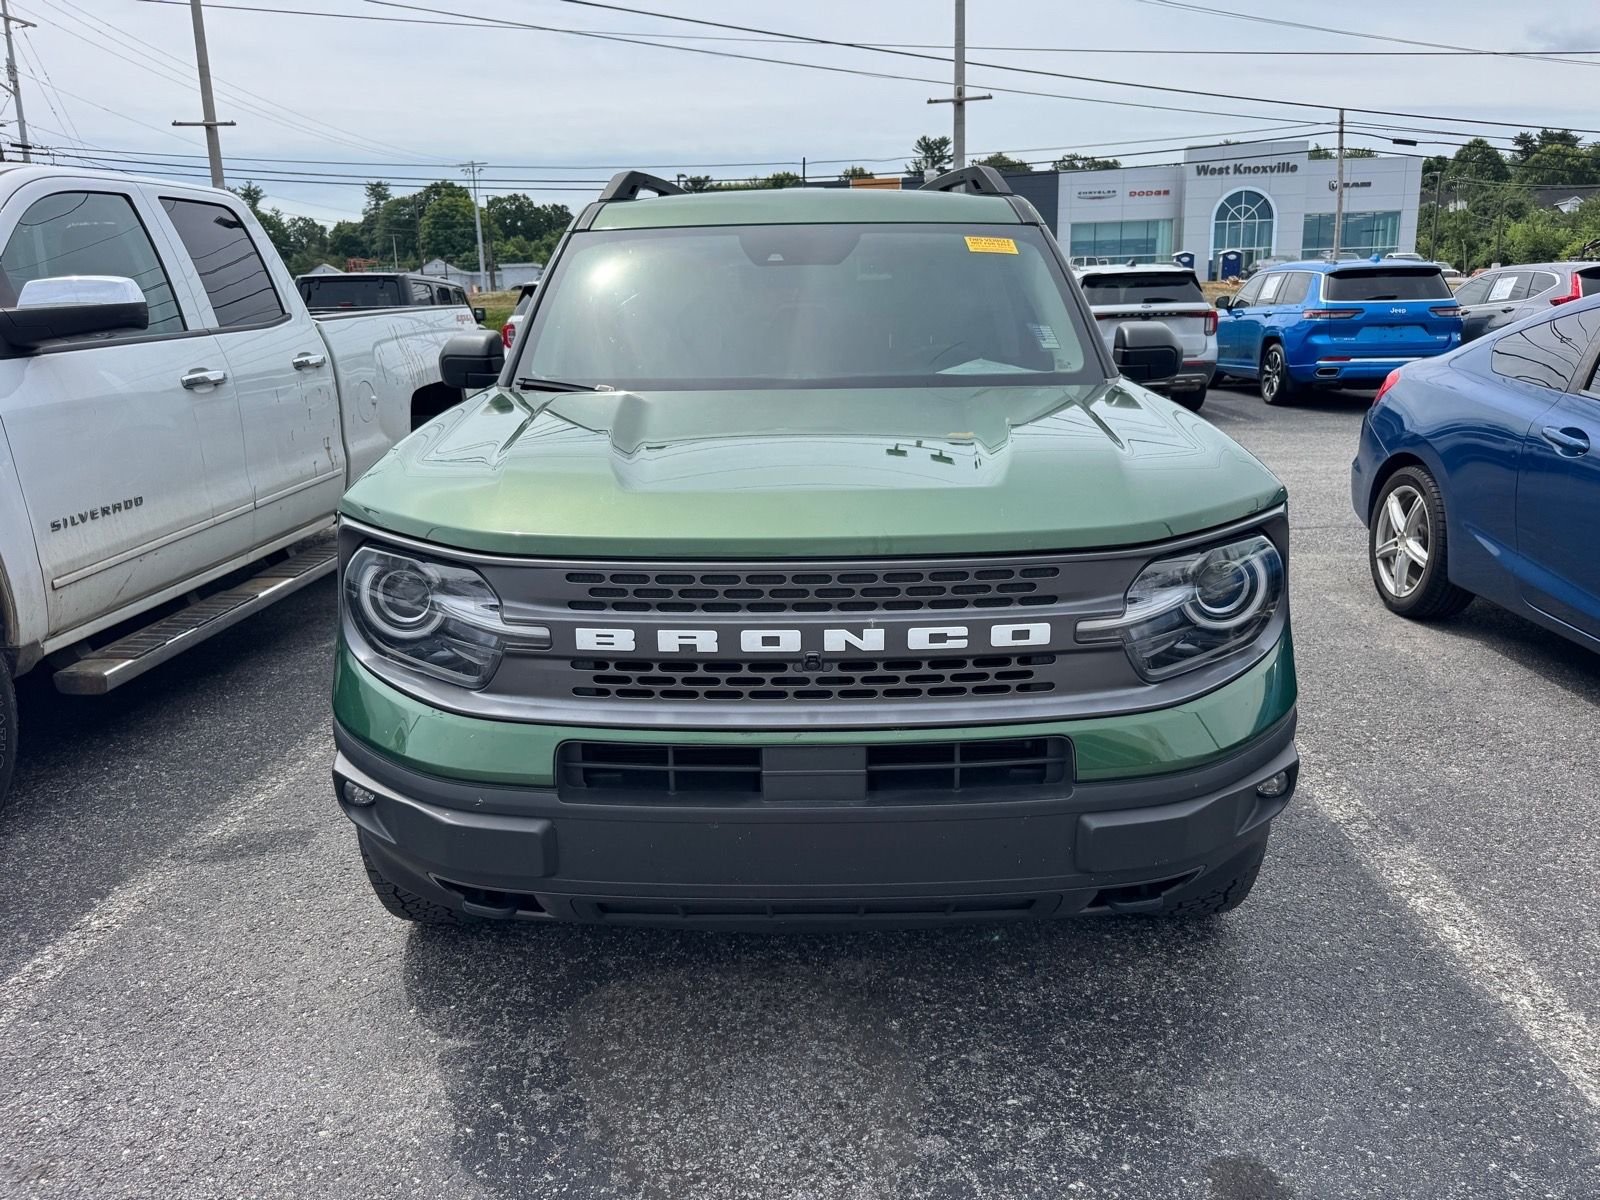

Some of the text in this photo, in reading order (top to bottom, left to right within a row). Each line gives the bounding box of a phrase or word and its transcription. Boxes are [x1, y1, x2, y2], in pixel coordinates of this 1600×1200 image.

[1196, 162, 1298, 176] West Knoxville
[50, 496, 144, 533] SILVERADO
[575, 622, 1051, 653] BRONCO
